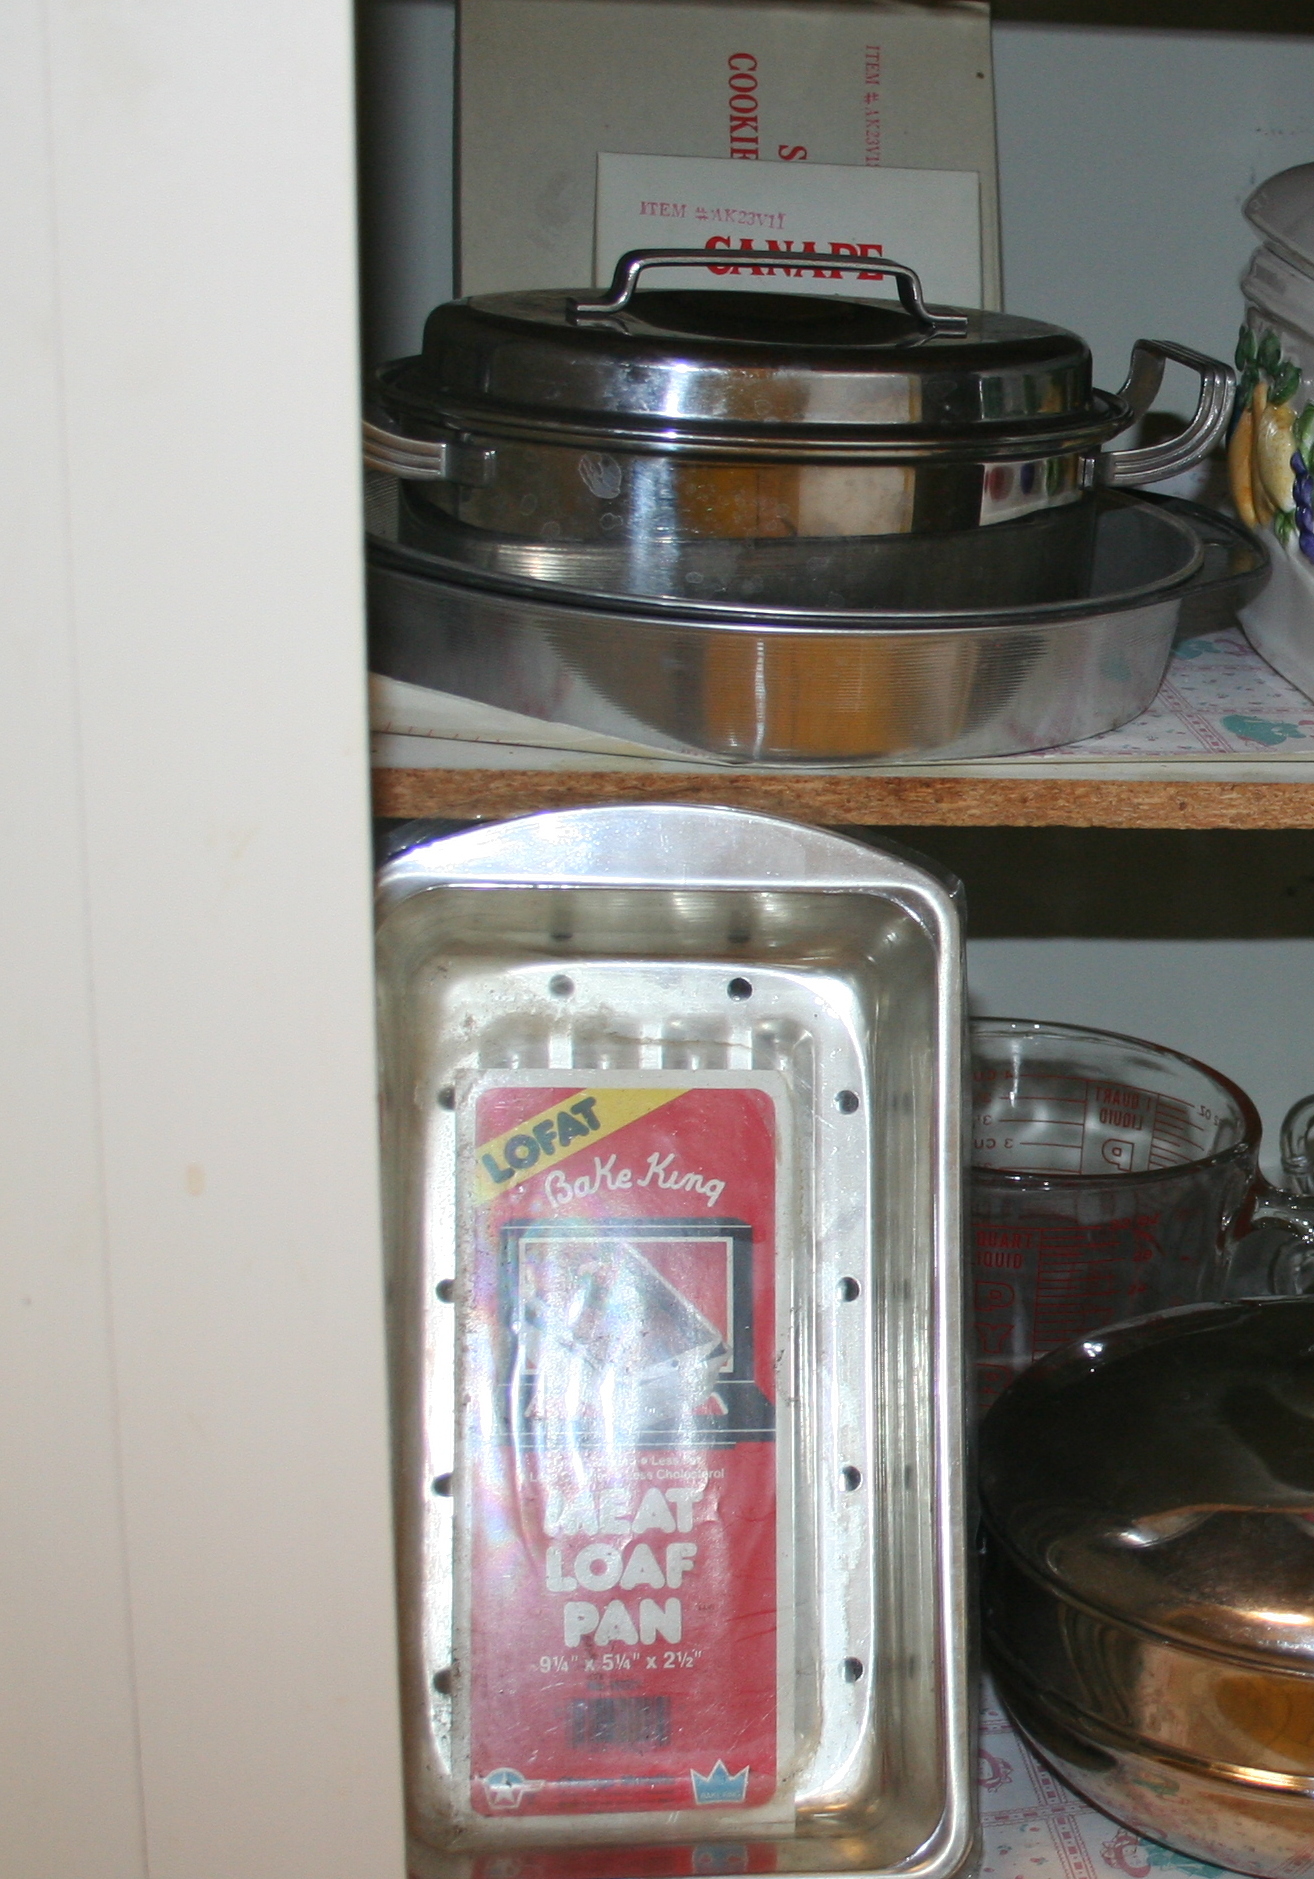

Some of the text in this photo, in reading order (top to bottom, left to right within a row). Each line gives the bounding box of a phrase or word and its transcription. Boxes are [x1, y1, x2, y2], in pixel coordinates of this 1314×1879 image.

[865, 45, 880, 85] ITEM
[640, 201, 687, 218] ITEM
[705, 236, 883, 281] CANAPE
[481, 1097, 600, 1184] LOFAT
[637, 1152, 726, 1207] King
[973, 1251, 1024, 1269] IQUID
[975, 1231, 1034, 1249] QUART
[543, 1487, 704, 1537] MEAT
[546, 1542, 698, 1592] LOAF
[564, 1597, 682, 1648] PAN
